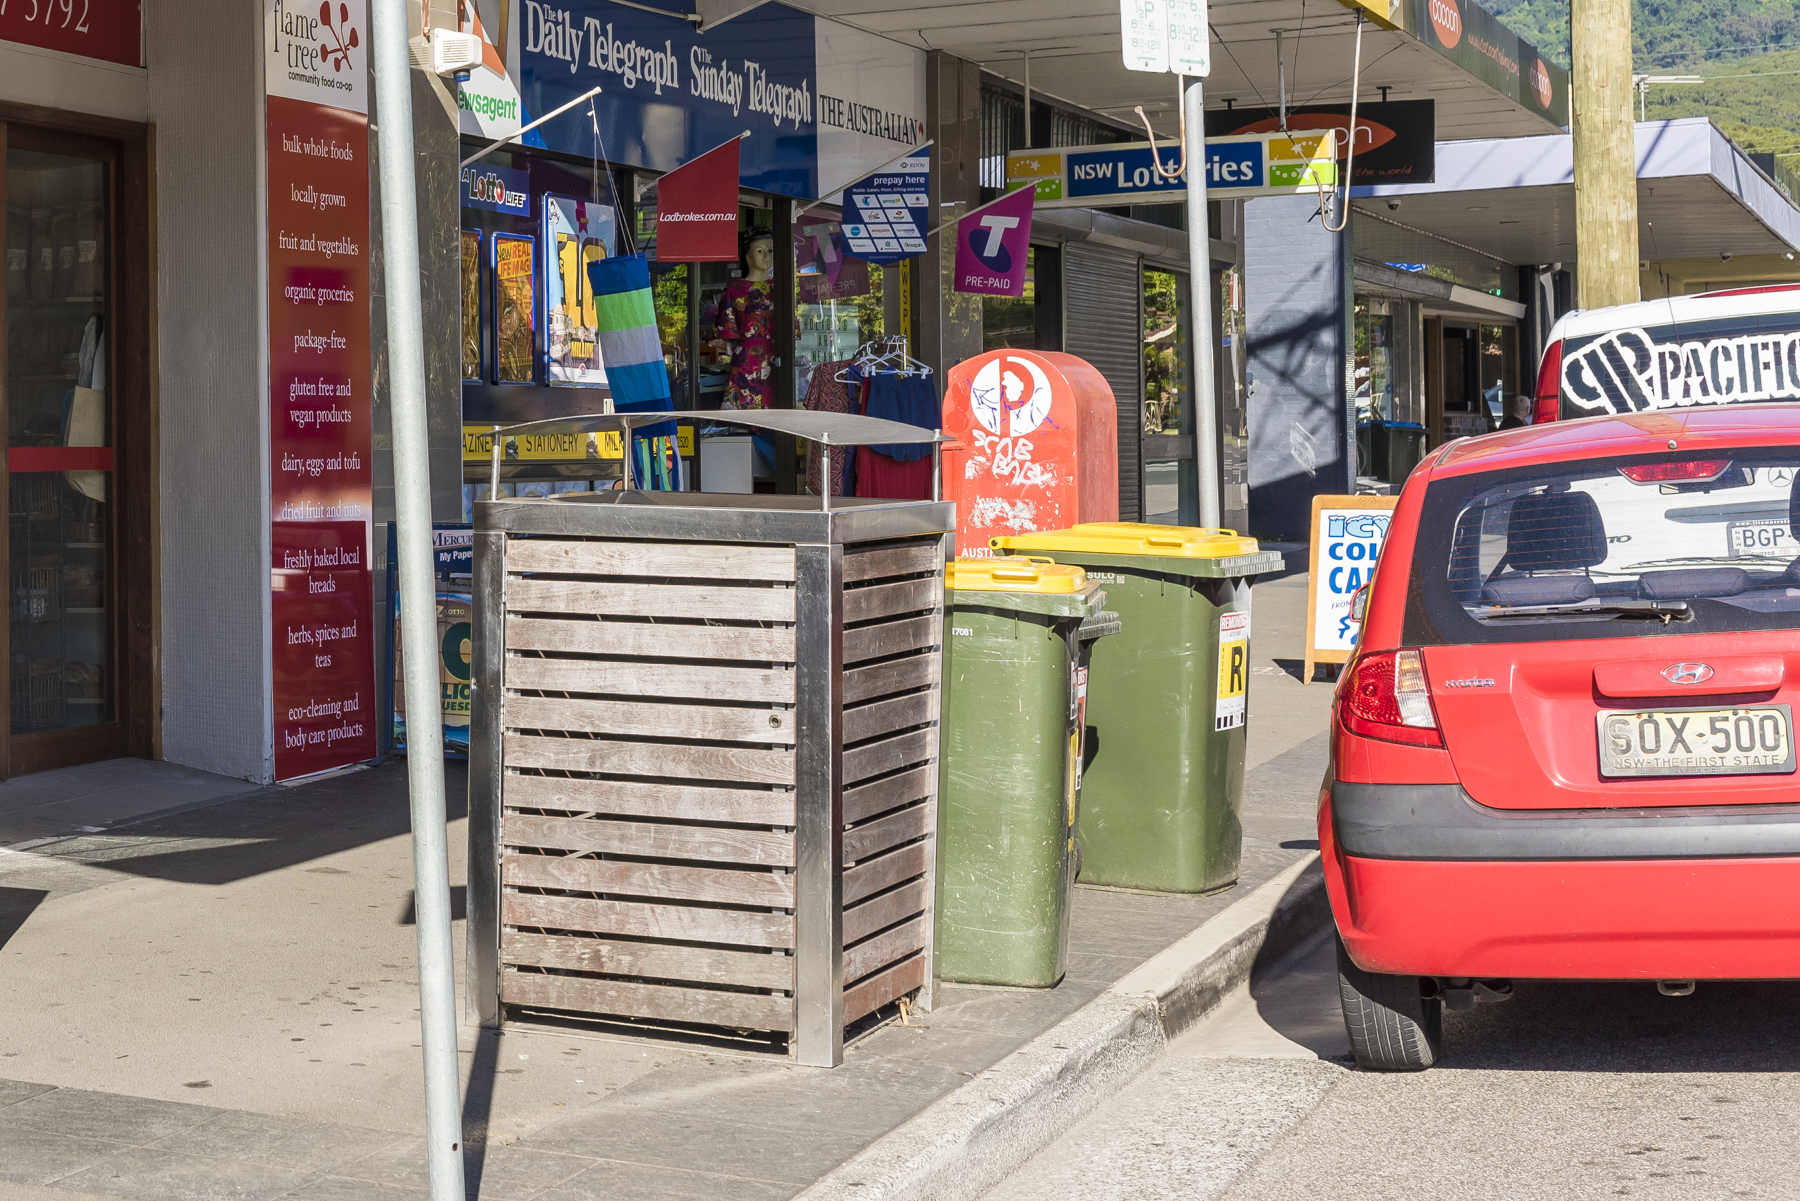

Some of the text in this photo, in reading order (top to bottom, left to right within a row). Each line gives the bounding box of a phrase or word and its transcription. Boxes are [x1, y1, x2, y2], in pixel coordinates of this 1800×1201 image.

[544, 4, 557, 23] The
[272, 0, 318, 53] flame
[287, 36, 319, 72] tree
[525, 0, 679, 90] Daily Telegraph
[701, 48, 712, 65] The
[288, 70, 353, 93] community food co-op
[690, 45, 812, 131] Sunday Telegraph
[459, 89, 517, 122] ewsagent
[819, 93, 918, 147] THE AUSTRALIAN
[282, 133, 353, 161] bulk whole foods
[873, 175, 925, 187] prepay here
[1073, 155, 1254, 189] NSW Lotties
[1356, 166, 1375, 177] the
[1379, 164, 1413, 176] world
[290, 183, 346, 210] locally grown
[469, 168, 506, 205] Lotto
[659, 211, 736, 223] Ladbrokes.com.au
[278, 230, 359, 258] fruit and vegetables
[512, 243, 531, 259] REAL
[284, 283, 354, 305] organic groceries
[965, 275, 1011, 289] PRE-PAID
[293, 331, 346, 353] package-free
[289, 378, 352, 401] gluten free and
[289, 402, 352, 427] vegan products
[525, 433, 579, 453] STATIONERY
[281, 451, 361, 476] dairy, eggs and tofu
[281, 501, 361, 520] dried fruit and nuts
[283, 546, 360, 573] freshly baked local
[439, 551, 452, 562] My
[308, 575, 336, 595] breads
[287, 620, 357, 647] herbs, spices and
[315, 653, 332, 669] teas
[1229, 646, 1244, 694] R
[1445, 678, 1495, 689] HYUNDAI
[288, 694, 359, 722] eco-cleaning and
[285, 723, 363, 752] body care products
[1685, 755, 1780, 767] FIRST STATE
